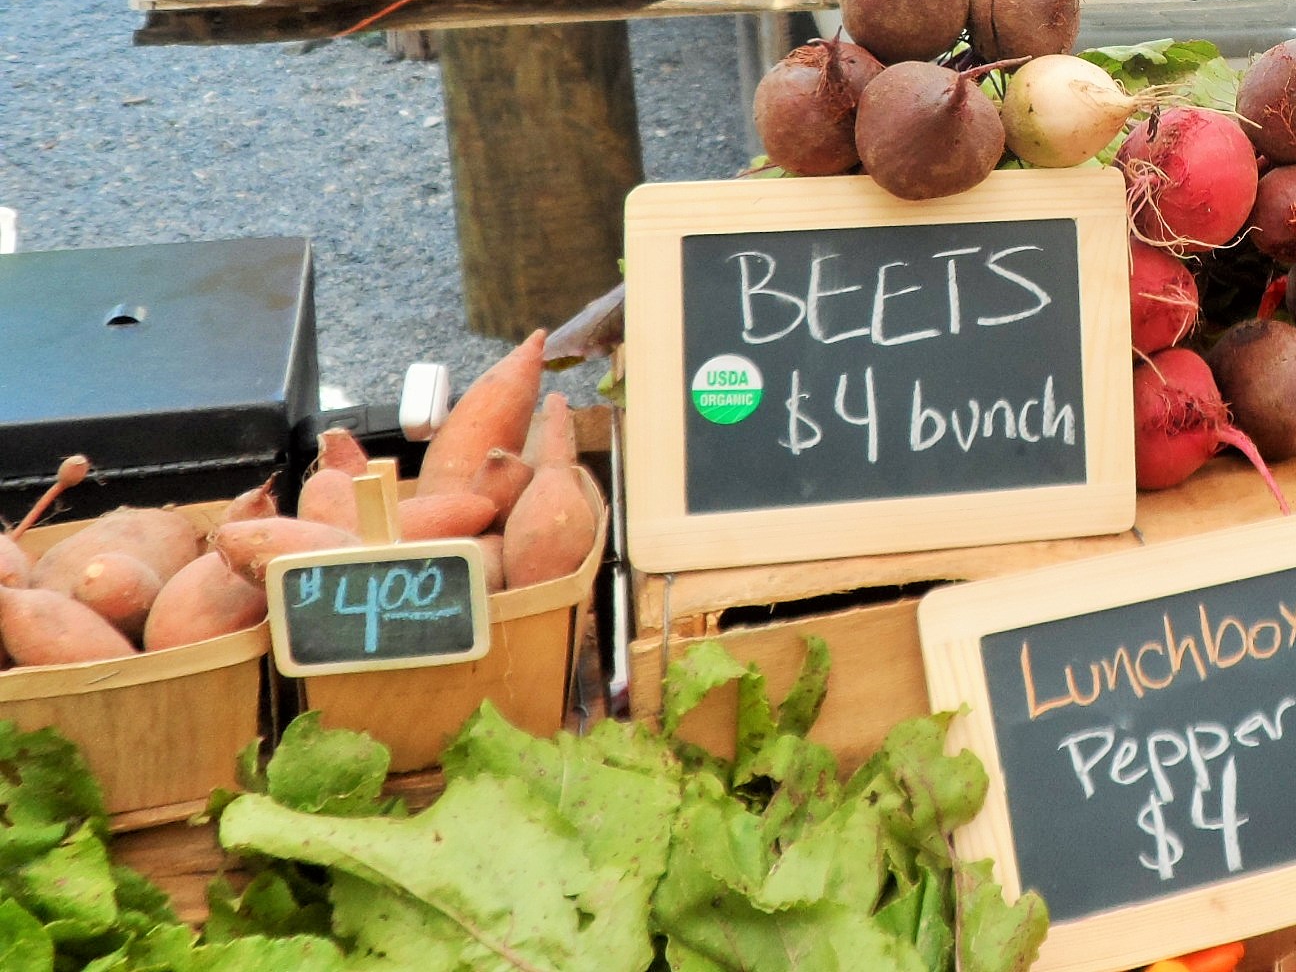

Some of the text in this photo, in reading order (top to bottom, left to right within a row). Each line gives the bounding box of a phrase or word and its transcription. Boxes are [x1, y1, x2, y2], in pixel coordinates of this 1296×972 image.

[727, 245, 1052, 346] BEETS
[700, 393, 754, 407] ORGANIC
[706, 370, 749, 387] USDA
[911, 374, 1077, 453] bunch
[1137, 754, 1250, 881] $4
